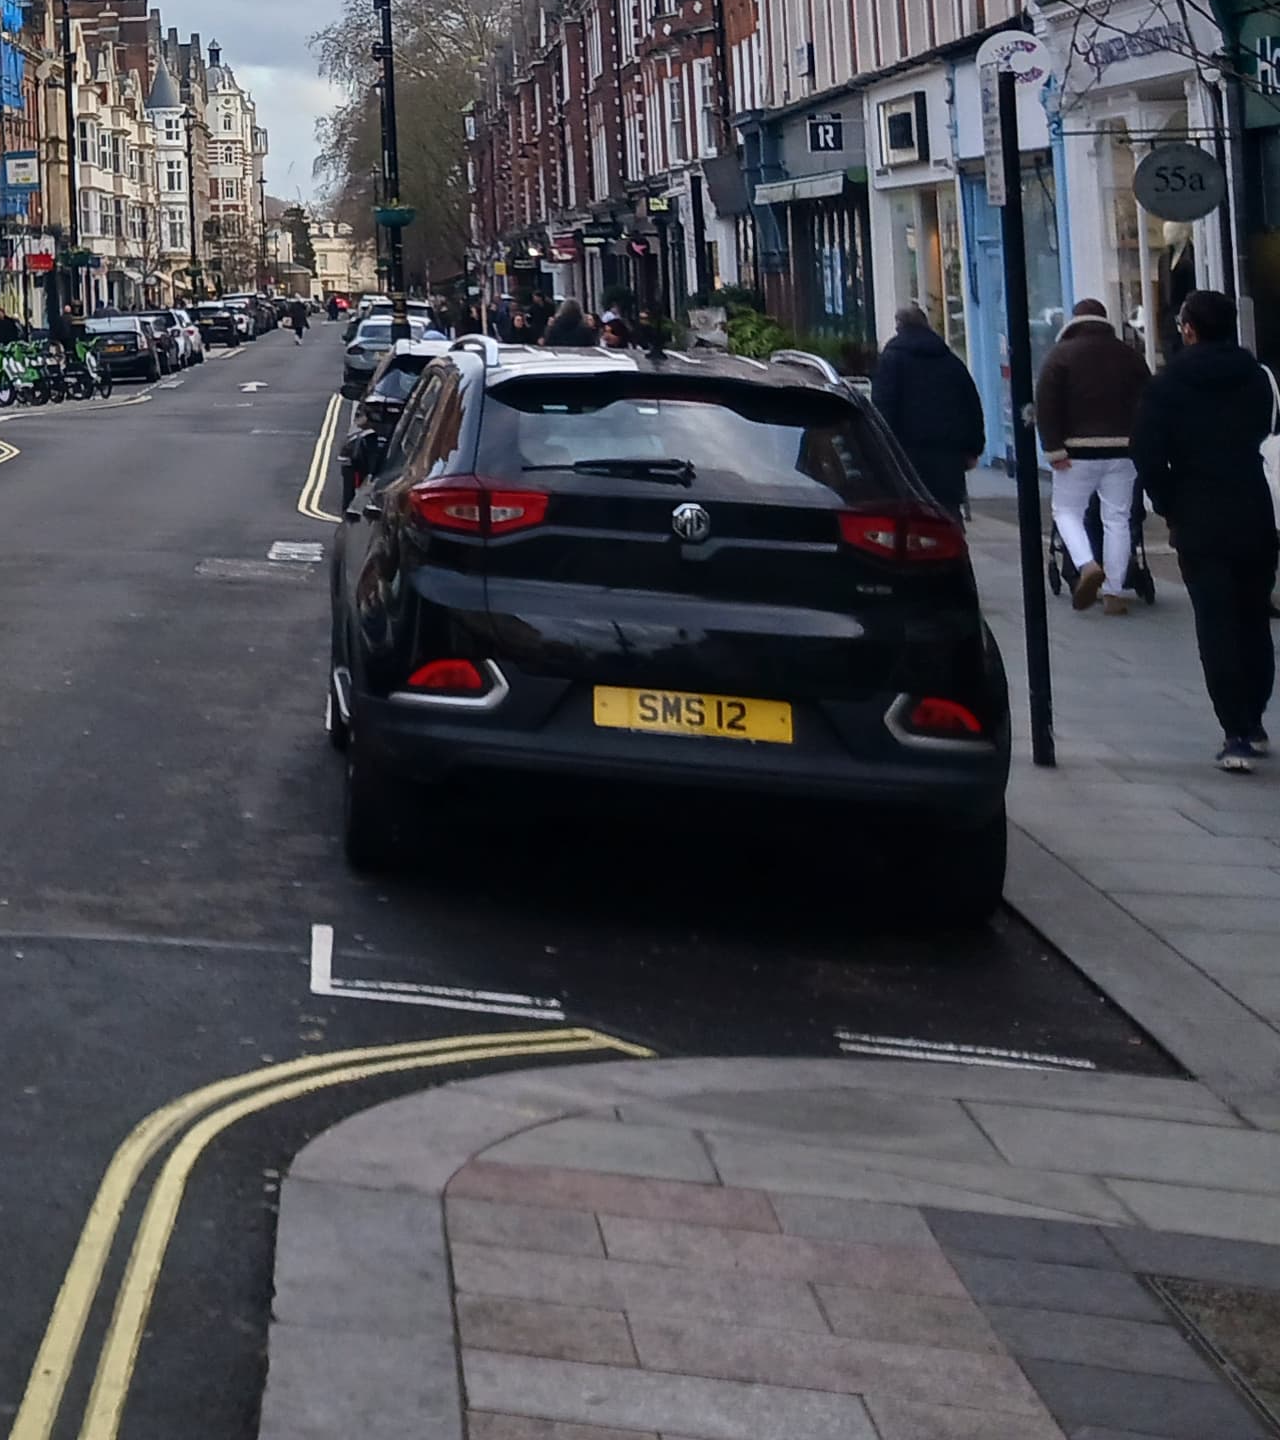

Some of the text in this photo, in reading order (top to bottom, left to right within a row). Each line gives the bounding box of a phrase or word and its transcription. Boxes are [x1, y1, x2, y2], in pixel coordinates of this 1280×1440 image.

[1154, 165, 1206, 193] 55a
[639, 693, 746, 731] SMS 12
